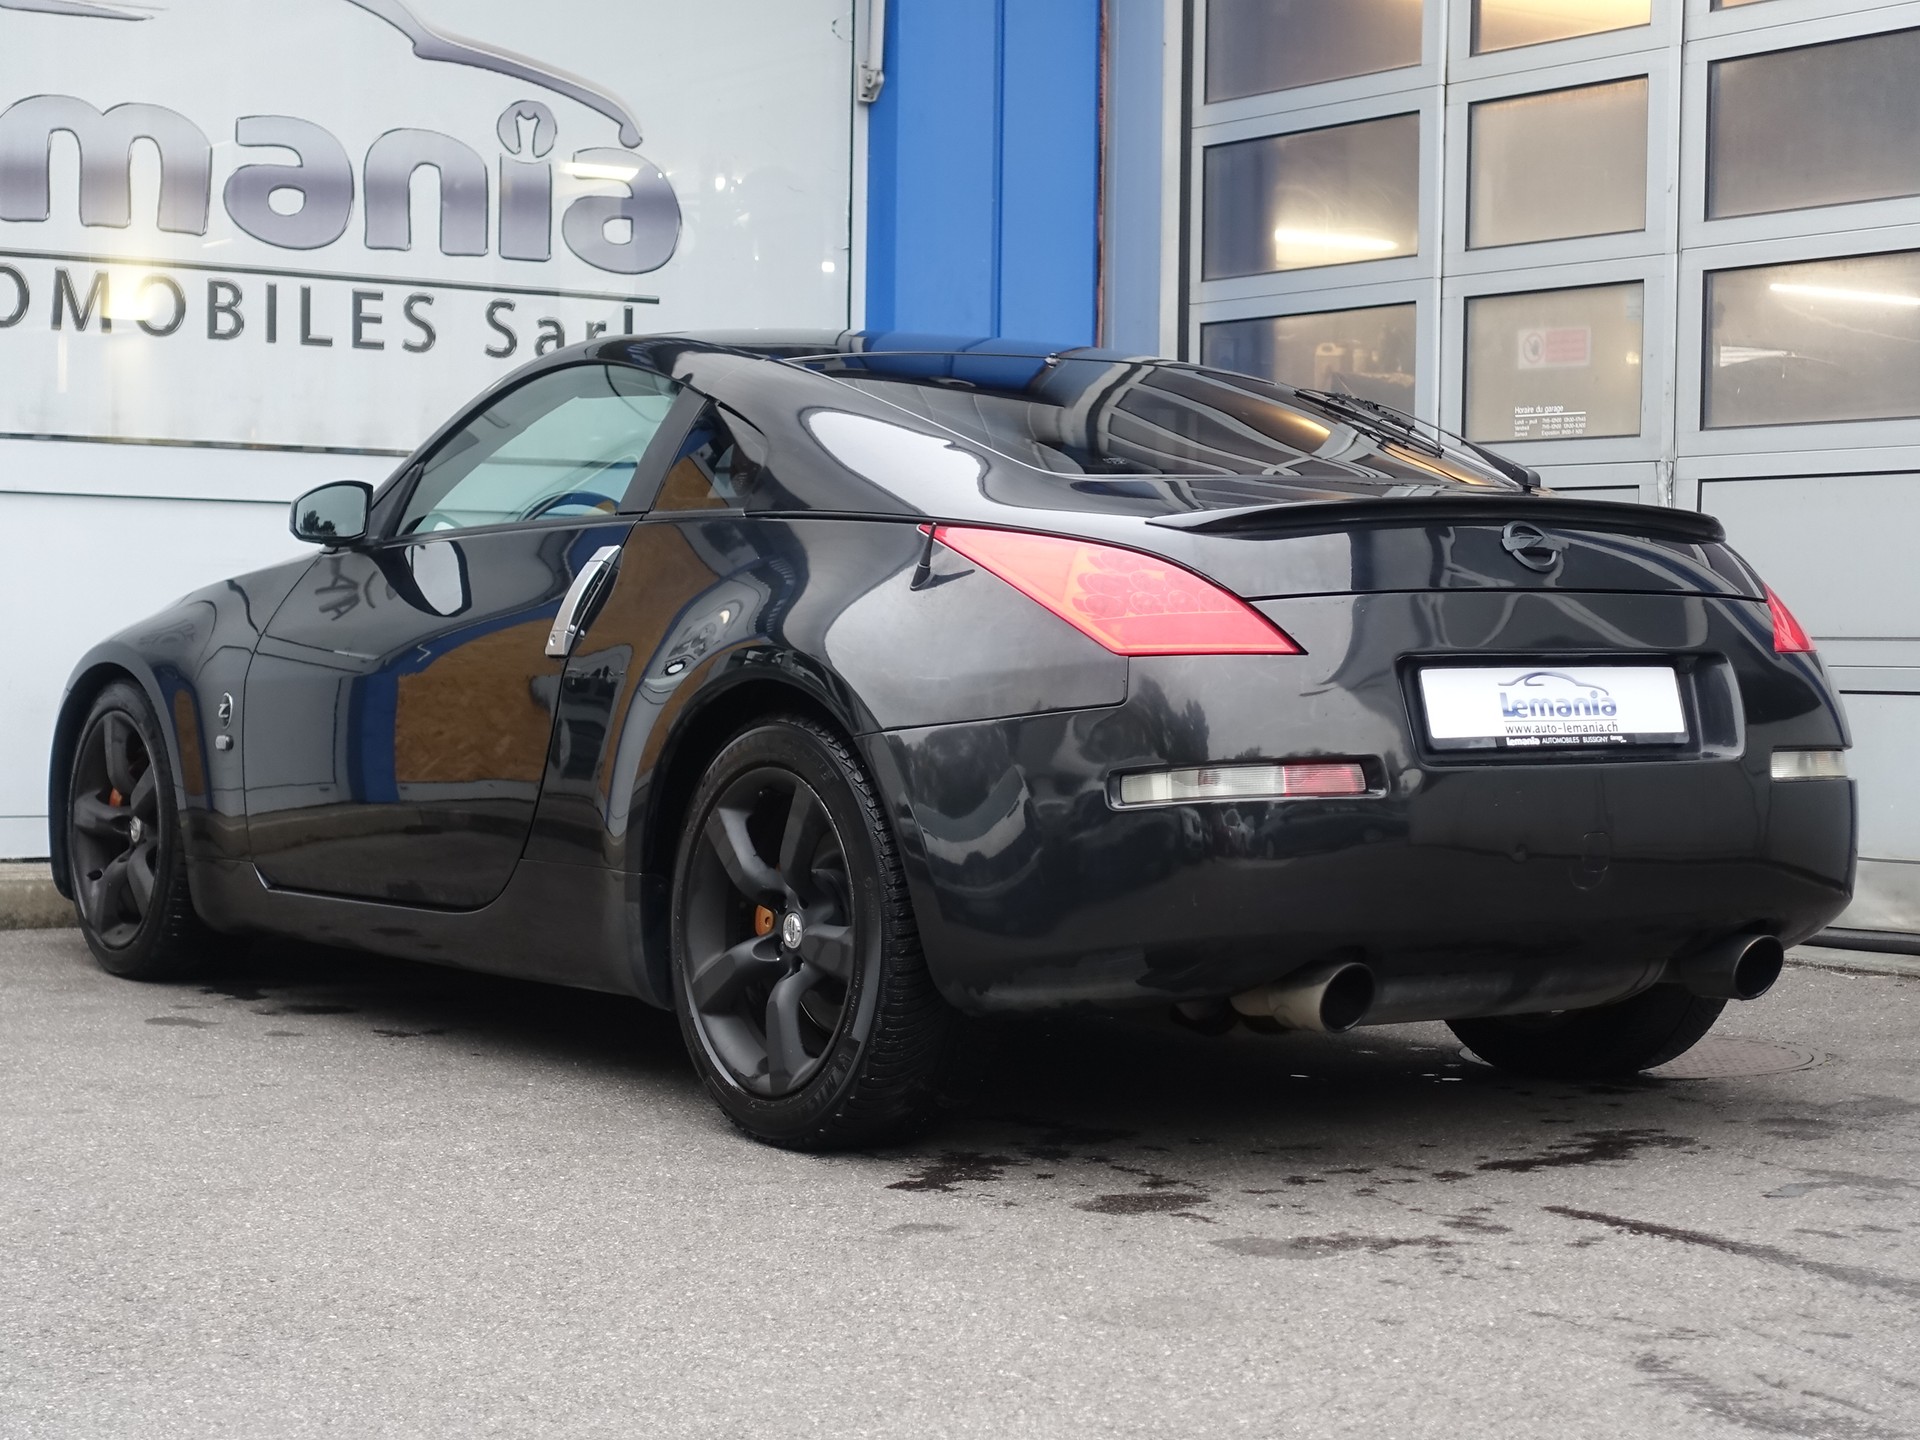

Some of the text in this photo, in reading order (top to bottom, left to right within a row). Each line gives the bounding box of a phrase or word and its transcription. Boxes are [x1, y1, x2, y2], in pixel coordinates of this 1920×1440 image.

[1515, 406, 1534, 414] Horaire
[1545, 405, 1564, 414] garage
[1500, 690, 1617, 718] Lemania
[1505, 722, 1618, 734] www.auto-lemania.ch
[1541, 736, 1580, 744] AUTOMOBILES
[1582, 735, 1608, 743] BUSSIGNY
